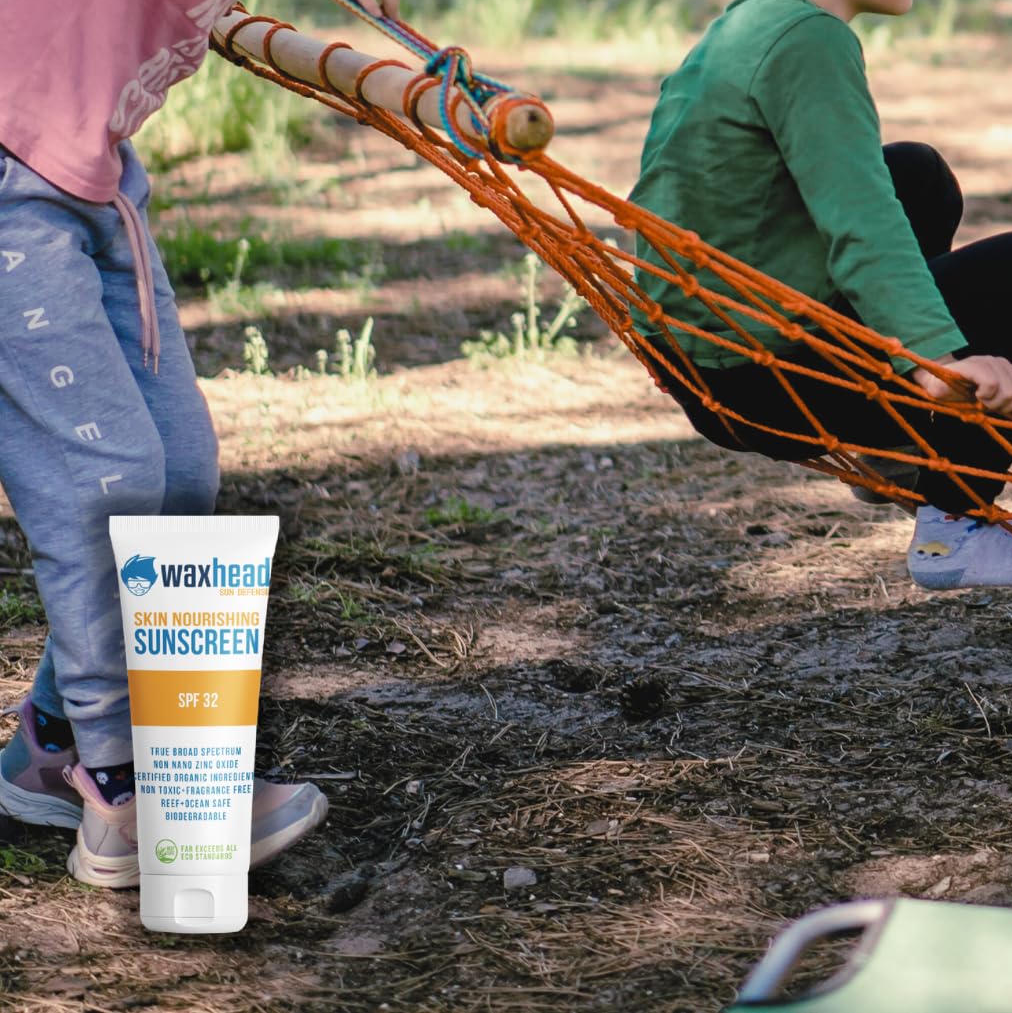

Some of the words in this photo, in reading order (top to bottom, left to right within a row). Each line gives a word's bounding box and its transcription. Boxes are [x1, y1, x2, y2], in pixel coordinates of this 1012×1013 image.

[1, 249, 123, 496] ANGEL
[161, 556, 271, 588] waxhead
[134, 612, 168, 627] SKIN
[172, 612, 260, 627] NOURISHING
[134, 628, 259, 656] SUNSCREEN
[178, 692, 200, 708] SPF
[203, 692, 219, 708] 32
[150, 747, 170, 757] TRUE
[172, 747, 198, 757] BROAD
[200, 747, 242, 757] SPECTRUM
[153, 759, 169, 769] NON
[171, 759, 192, 770] NANO
[195, 760, 213, 770] ZINC
[216, 759, 239, 769] OXIDE
[174, 773, 208, 782] ORGANIC
[140, 784, 156, 794] NON
[233, 784, 252, 794] FREE
[212, 798, 231, 807] SAFE
[165, 811, 227, 821] BIODEGRADABLE
